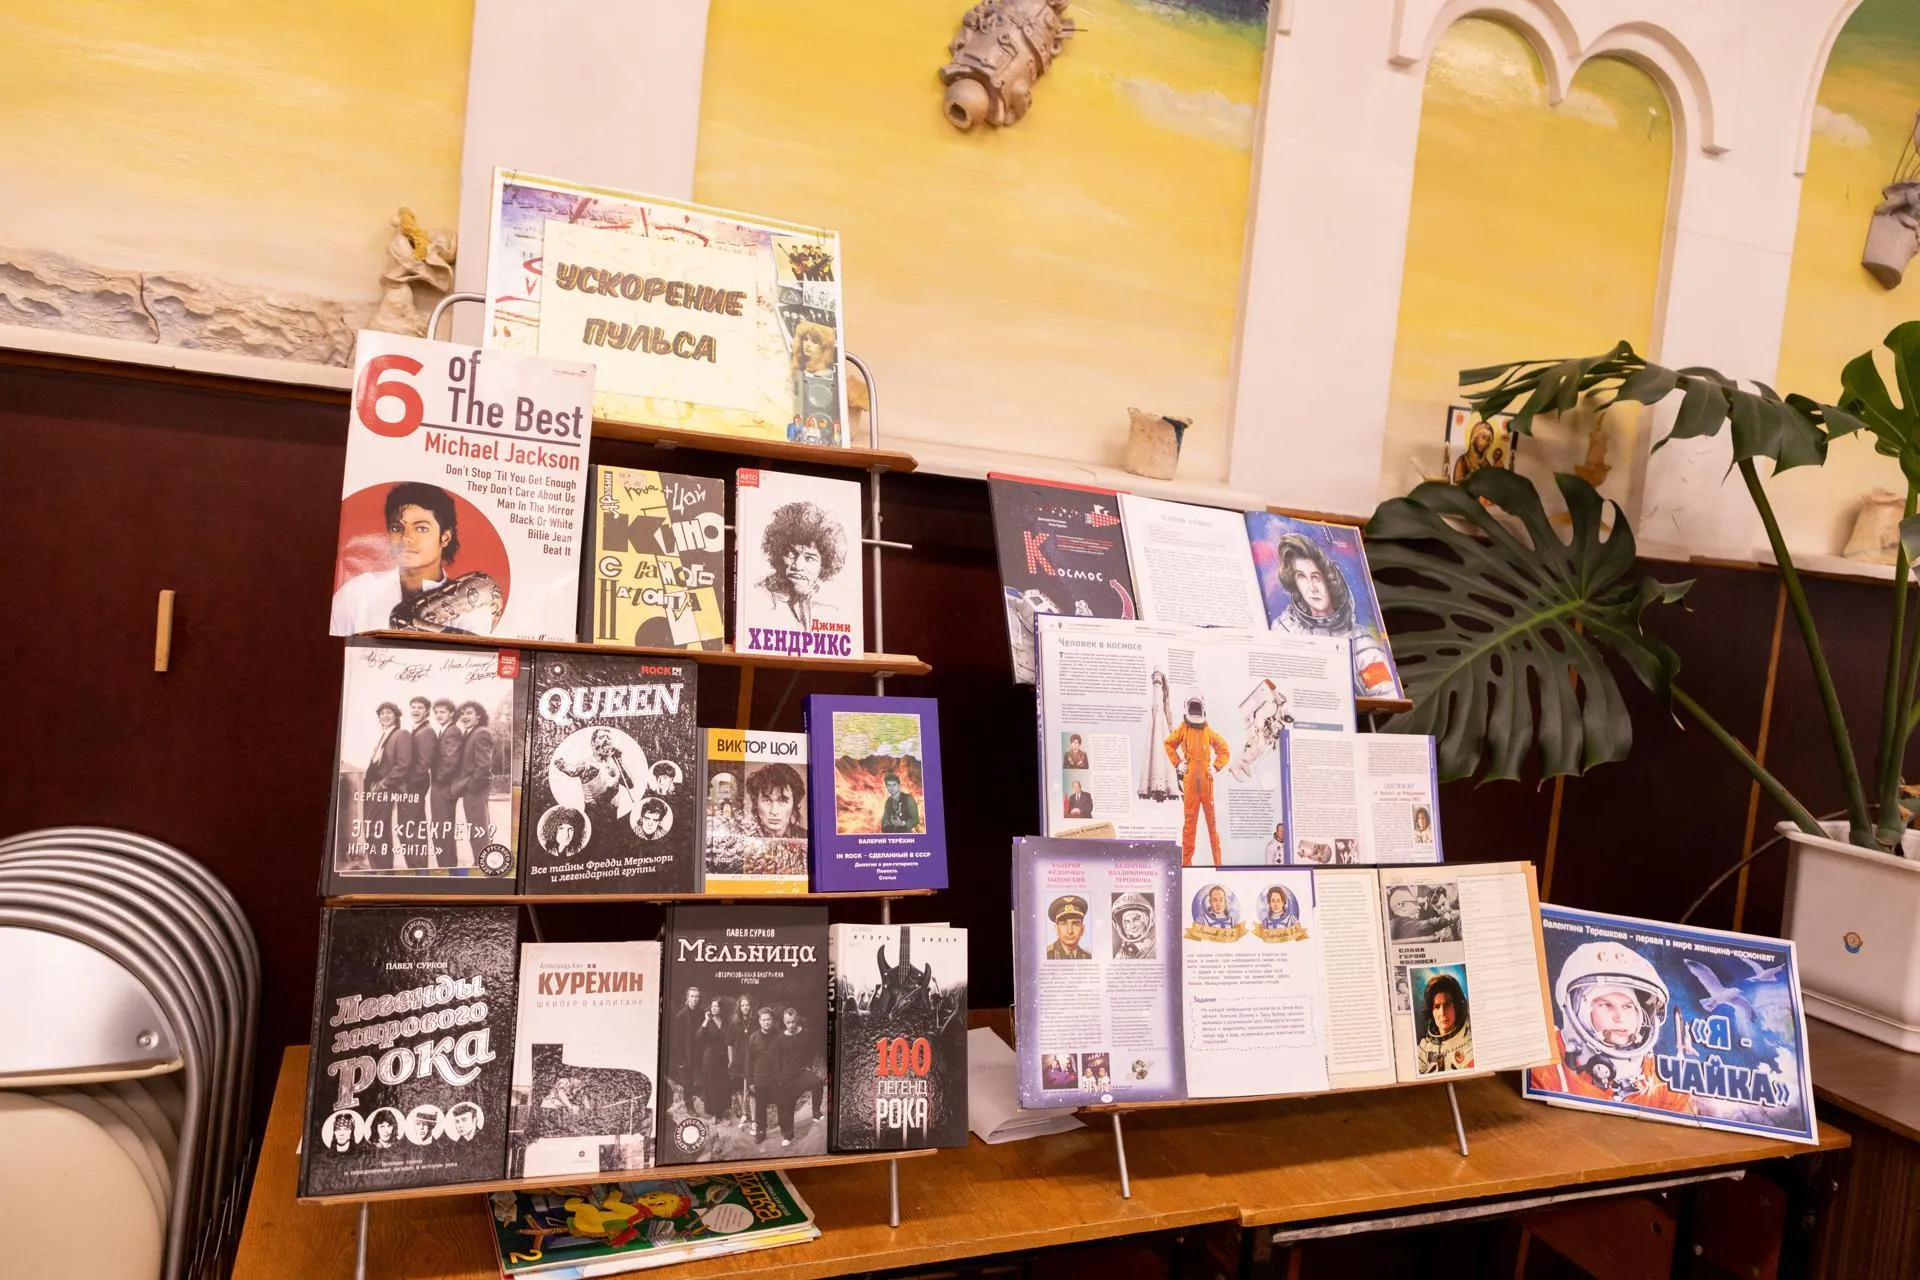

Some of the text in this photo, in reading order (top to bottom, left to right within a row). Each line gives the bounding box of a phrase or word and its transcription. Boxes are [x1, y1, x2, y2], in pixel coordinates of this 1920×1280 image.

[555, 261, 748, 317] УСКОРЕНИЕ
[583, 317, 717, 363] ПУЛЬСА
[356, 350, 482, 437] 6 of
[447, 386, 583, 439] The Best
[425, 431, 580, 471] Michael Jackson
[472, 467, 492, 480] Stop
[510, 471, 526, 484] You
[528, 474, 542, 486] Get
[546, 477, 577, 490] Enough
[467, 480, 487, 495] They
[515, 487, 536, 498] Care
[538, 490, 562, 502] About
[565, 493, 576, 503] Us
[497, 499, 574, 516] Man In The Mirror
[510, 513, 573, 530] Black Or White
[528, 528, 572, 543] Billie Jean
[602, 511, 724, 556] КИНО
[543, 544, 571, 556] Beat It
[812, 619, 851, 632] Джими
[748, 628, 851, 657] ХЕНДРИКС
[1058, 637, 1096, 648] Человек
[1107, 642, 1142, 650] космосе
[641, 665, 672, 676] ROCK
[538, 683, 684, 726] QUEEN
[717, 739, 798, 756] ВИКТОР ЦОЙ
[354, 792, 419, 804] СЕРГЕЙ МИРОВ
[351, 819, 384, 839] ЭТО
[348, 843, 377, 856] ИГРА
[381, 844, 388, 855] В
[869, 851, 908, 859] СДЕЛАННЫЙ
[531, 854, 673, 876] Все тайны Фредди Меркьюри
[559, 868, 620, 882] легендарной
[622, 866, 656, 879] группы
[726, 928, 775, 937] ПАВЕЛ СУРКОВ
[1542, 918, 1583, 934] Валентина
[1585, 925, 1627, 940] Терешкова
[1635, 934, 1664, 947] первая
[1665, 938, 1671, 946] в
[1672, 940, 1693, 951] мире
[1693, 943, 1776, 963] женщина-космонавт
[386, 961, 448, 970] ПАВЕЛ СУРКОВ
[538, 963, 644, 995] КУРЁХИН
[330, 974, 485, 1027] Легенды
[536, 1000, 578, 1008] ШКИПЕР
[592, 999, 643, 1007] КАПИТАНЕ
[332, 1001, 488, 1053] мирового
[1691, 1015, 1731, 1050] «Я
[875, 1037, 932, 1077] 100
[327, 1027, 497, 1112] рока
[1656, 1053, 1790, 1108] ЧАЙКА»
[877, 1080, 928, 1097] ЛЕГЕНД
[876, 1098, 928, 1130] РОКА
